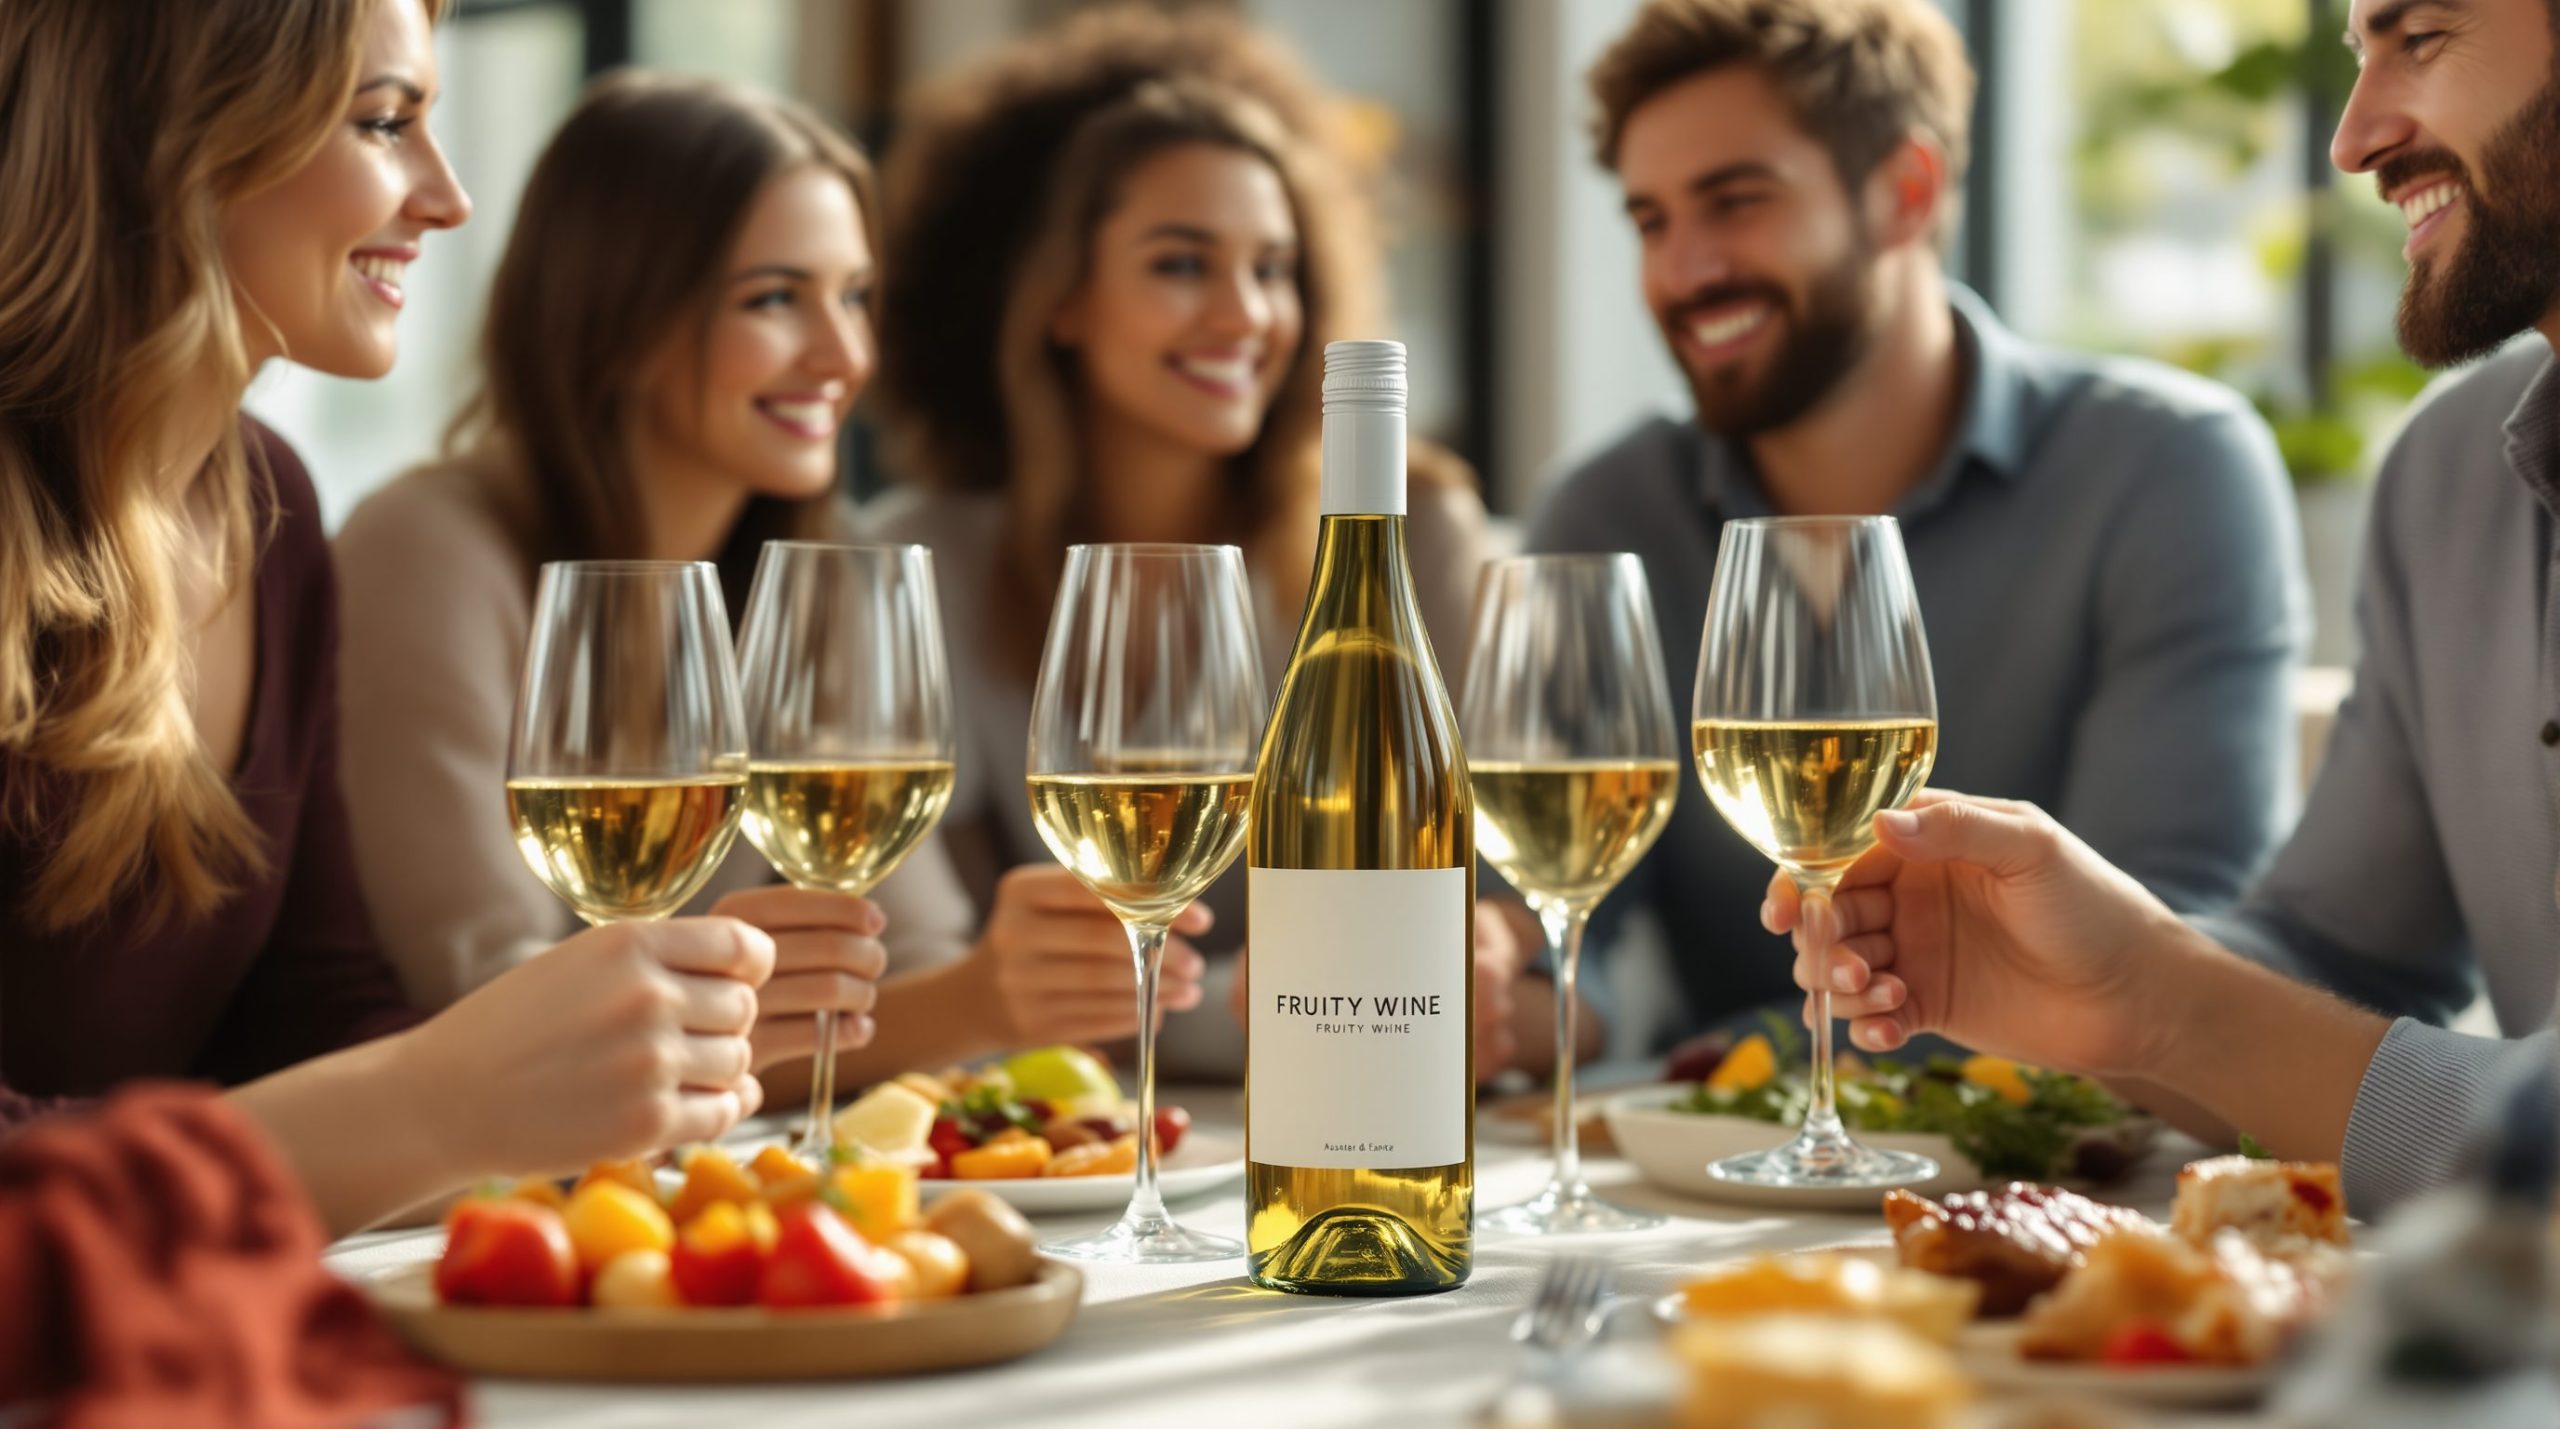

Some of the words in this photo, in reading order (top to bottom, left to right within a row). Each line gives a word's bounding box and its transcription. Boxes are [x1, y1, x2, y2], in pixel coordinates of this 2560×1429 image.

[1277, 994, 1364, 1017] FRUITY
[1373, 995, 1441, 1017] WINE
[1315, 1023, 1365, 1034] FRUITY
